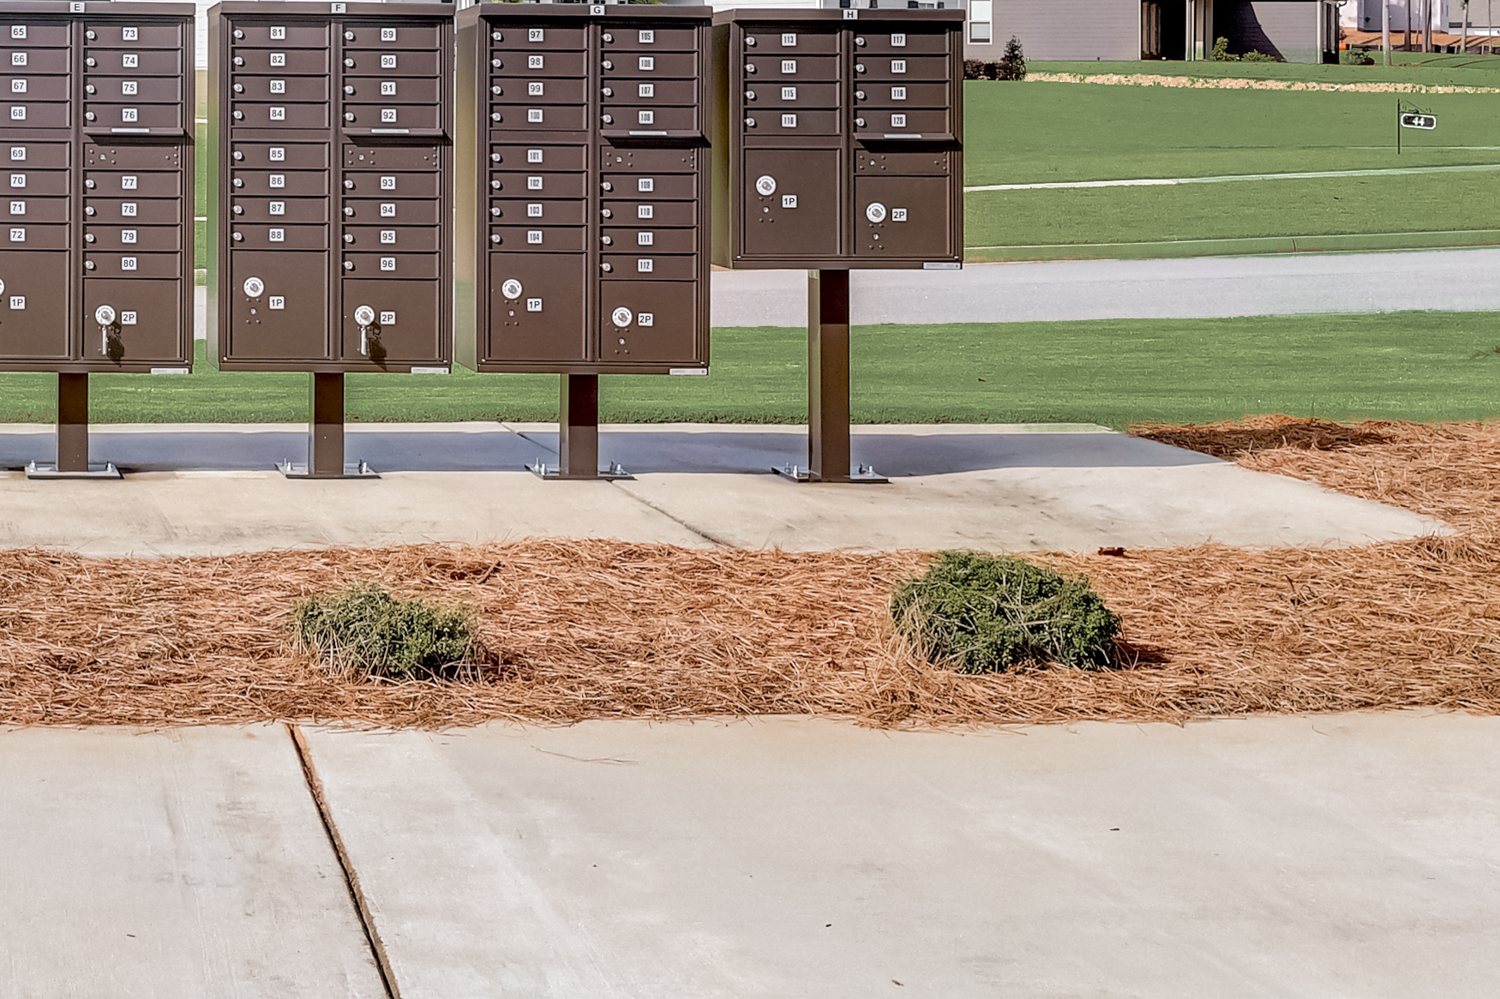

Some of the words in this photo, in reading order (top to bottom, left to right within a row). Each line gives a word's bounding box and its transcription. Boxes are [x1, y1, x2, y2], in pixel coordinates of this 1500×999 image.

[73, 3, 81, 11] E
[335, 4, 342, 12] F
[593, 6, 601, 14] G
[846, 10, 854, 18] H
[13, 27, 25, 37] 65
[124, 29, 136, 38] 73
[272, 28, 283, 37] 81
[382, 29, 394, 39] 89
[530, 30, 541, 39] 97
[13, 54, 25, 64] 66
[124, 56, 136, 65] 74
[272, 55, 283, 64] 82
[383, 57, 394, 66] 90
[530, 57, 541, 66] 98
[13, 81, 25, 91] 67
[124, 83, 136, 93] 75
[272, 82, 283, 91] 83
[382, 84, 393, 93] 91
[530, 84, 541, 93] 99
[12, 108, 24, 118] 68
[124, 110, 136, 120] 76
[271, 109, 283, 118] 84
[383, 111, 394, 120] 92
[1412, 116, 1425, 126] 44
[12, 149, 24, 158] 69
[271, 149, 283, 159] 85
[12, 176, 24, 185] 70
[123, 178, 135, 187] 77
[271, 176, 283, 186] 86
[382, 178, 394, 188] 93
[784, 197, 795, 206] 1P
[12, 203, 23, 212] 71
[123, 205, 135, 214] 78
[271, 203, 283, 213] 87
[382, 205, 394, 214] 94
[894, 210, 905, 220] 2P
[12, 230, 23, 239] 72
[123, 232, 135, 241] 79
[271, 230, 282, 240] 88
[382, 232, 394, 241] 95
[123, 259, 135, 268] 80
[382, 259, 394, 269] 96
[11, 298, 24, 307] 1P
[271, 298, 283, 307] 1P
[529, 300, 540, 309] 1P
[123, 313, 135, 322] 2P
[382, 313, 394, 323] 2P
[640, 315, 651, 324] 2P
